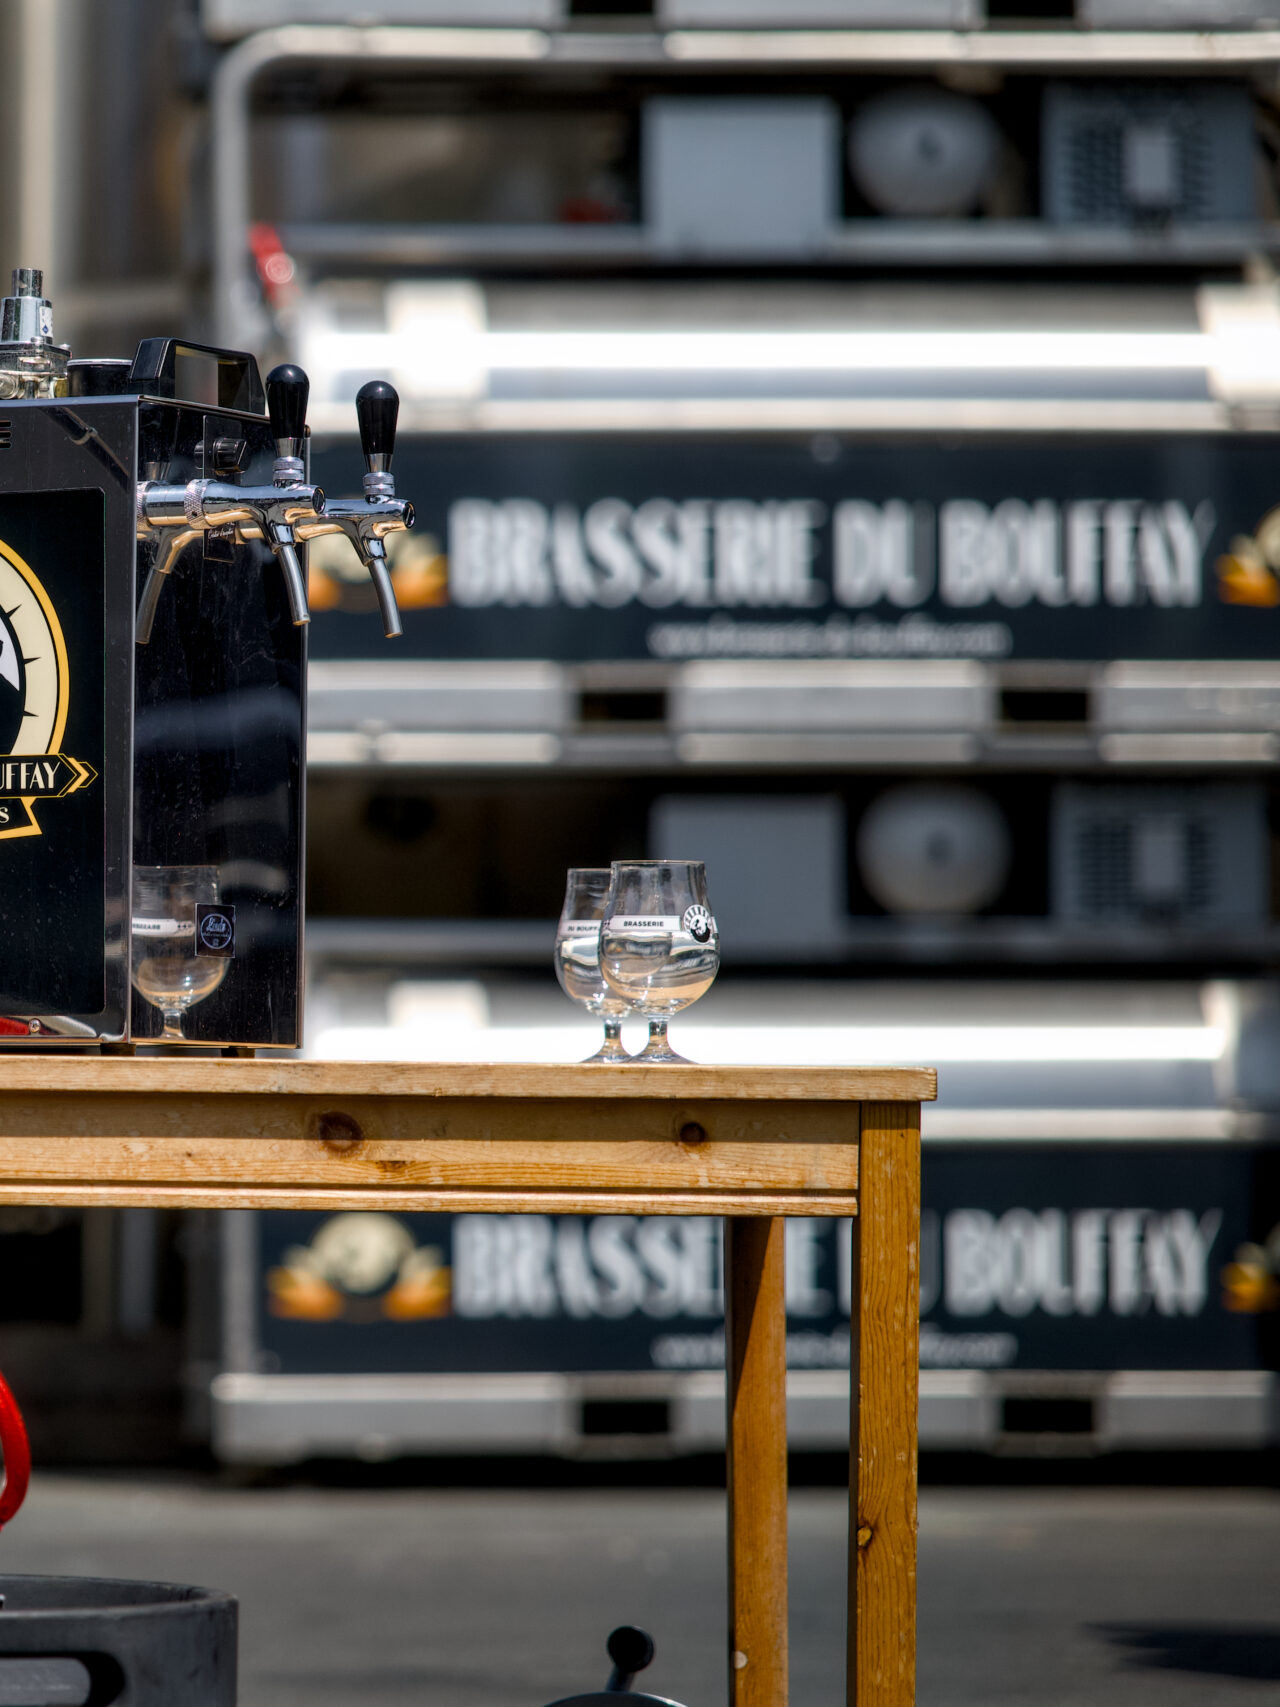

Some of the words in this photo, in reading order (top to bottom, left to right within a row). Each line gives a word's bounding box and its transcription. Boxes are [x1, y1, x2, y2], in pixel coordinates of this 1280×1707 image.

[449, 498, 827, 607] BRASSERIE
[833, 498, 936, 607] DU
[451, 1212, 837, 1319] BRASSEE
